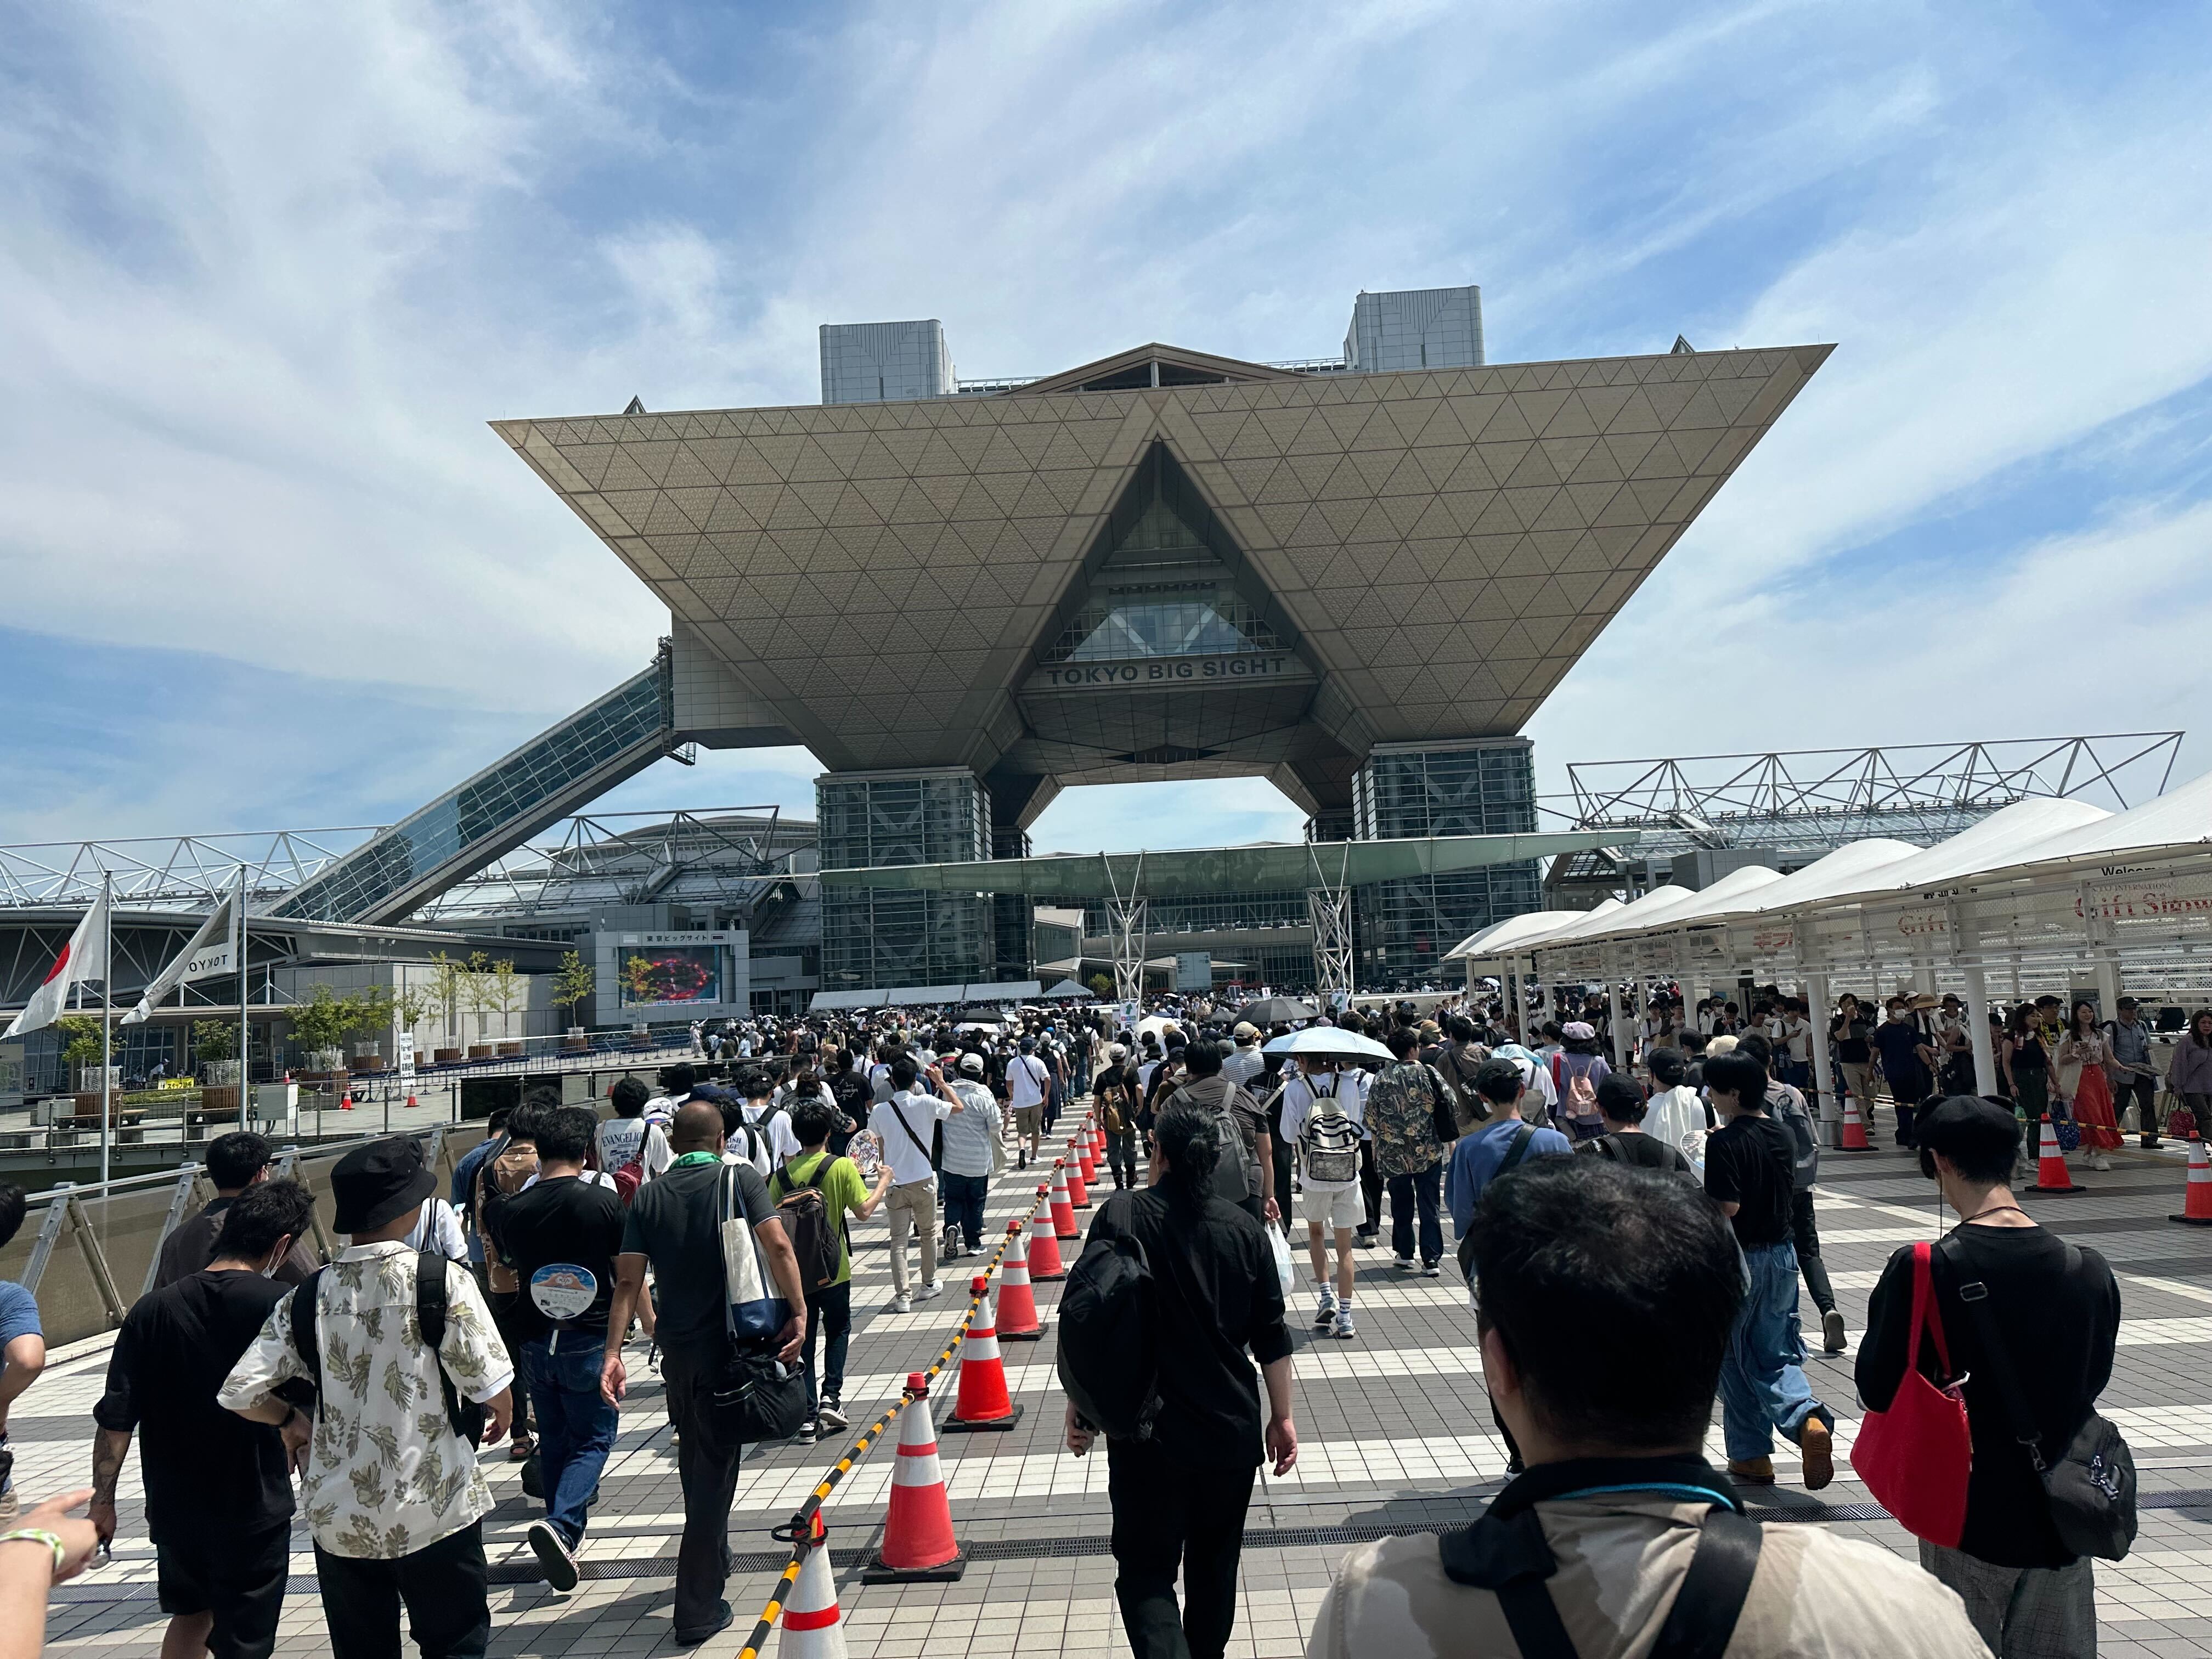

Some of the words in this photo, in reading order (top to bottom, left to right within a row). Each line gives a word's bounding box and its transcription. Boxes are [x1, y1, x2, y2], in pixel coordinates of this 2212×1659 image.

[1047, 665, 1138, 685] TOKYO
[1148, 662, 1193, 680] BIG
[1202, 657, 1286, 677] SIGHT
[602, 1132, 644, 1147] EVANGELIO
